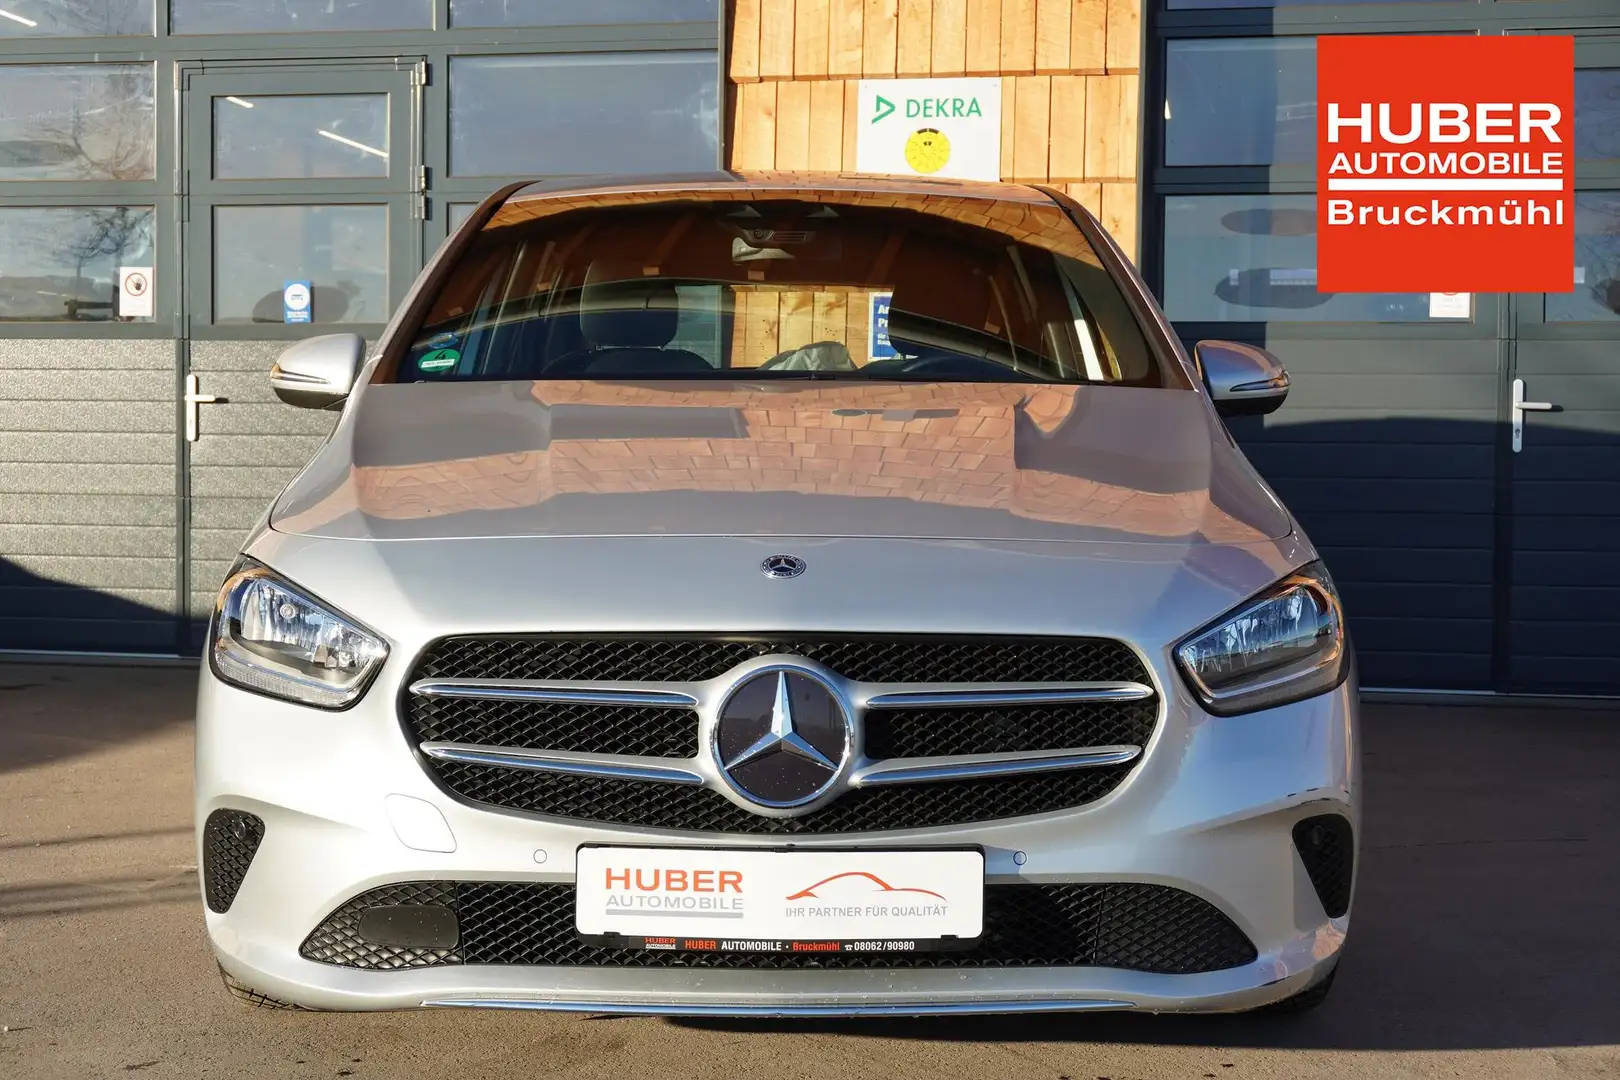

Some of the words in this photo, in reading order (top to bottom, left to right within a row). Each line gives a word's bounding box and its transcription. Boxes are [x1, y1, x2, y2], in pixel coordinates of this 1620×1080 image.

[906, 97, 982, 118] DEKRA
[605, 867, 744, 893] HUBER
[605, 894, 745, 910] AUTOMOBILE
[785, 907, 805, 917] IHR
[808, 907, 862, 917] PARTNER
[865, 905, 888, 917] FÜR
[891, 904, 948, 917] QUALITÄT
[684, 940, 717, 950] HUBER
[721, 941, 782, 951] AUTOMOBILE
[792, 941, 841, 951] Bruckmühl
